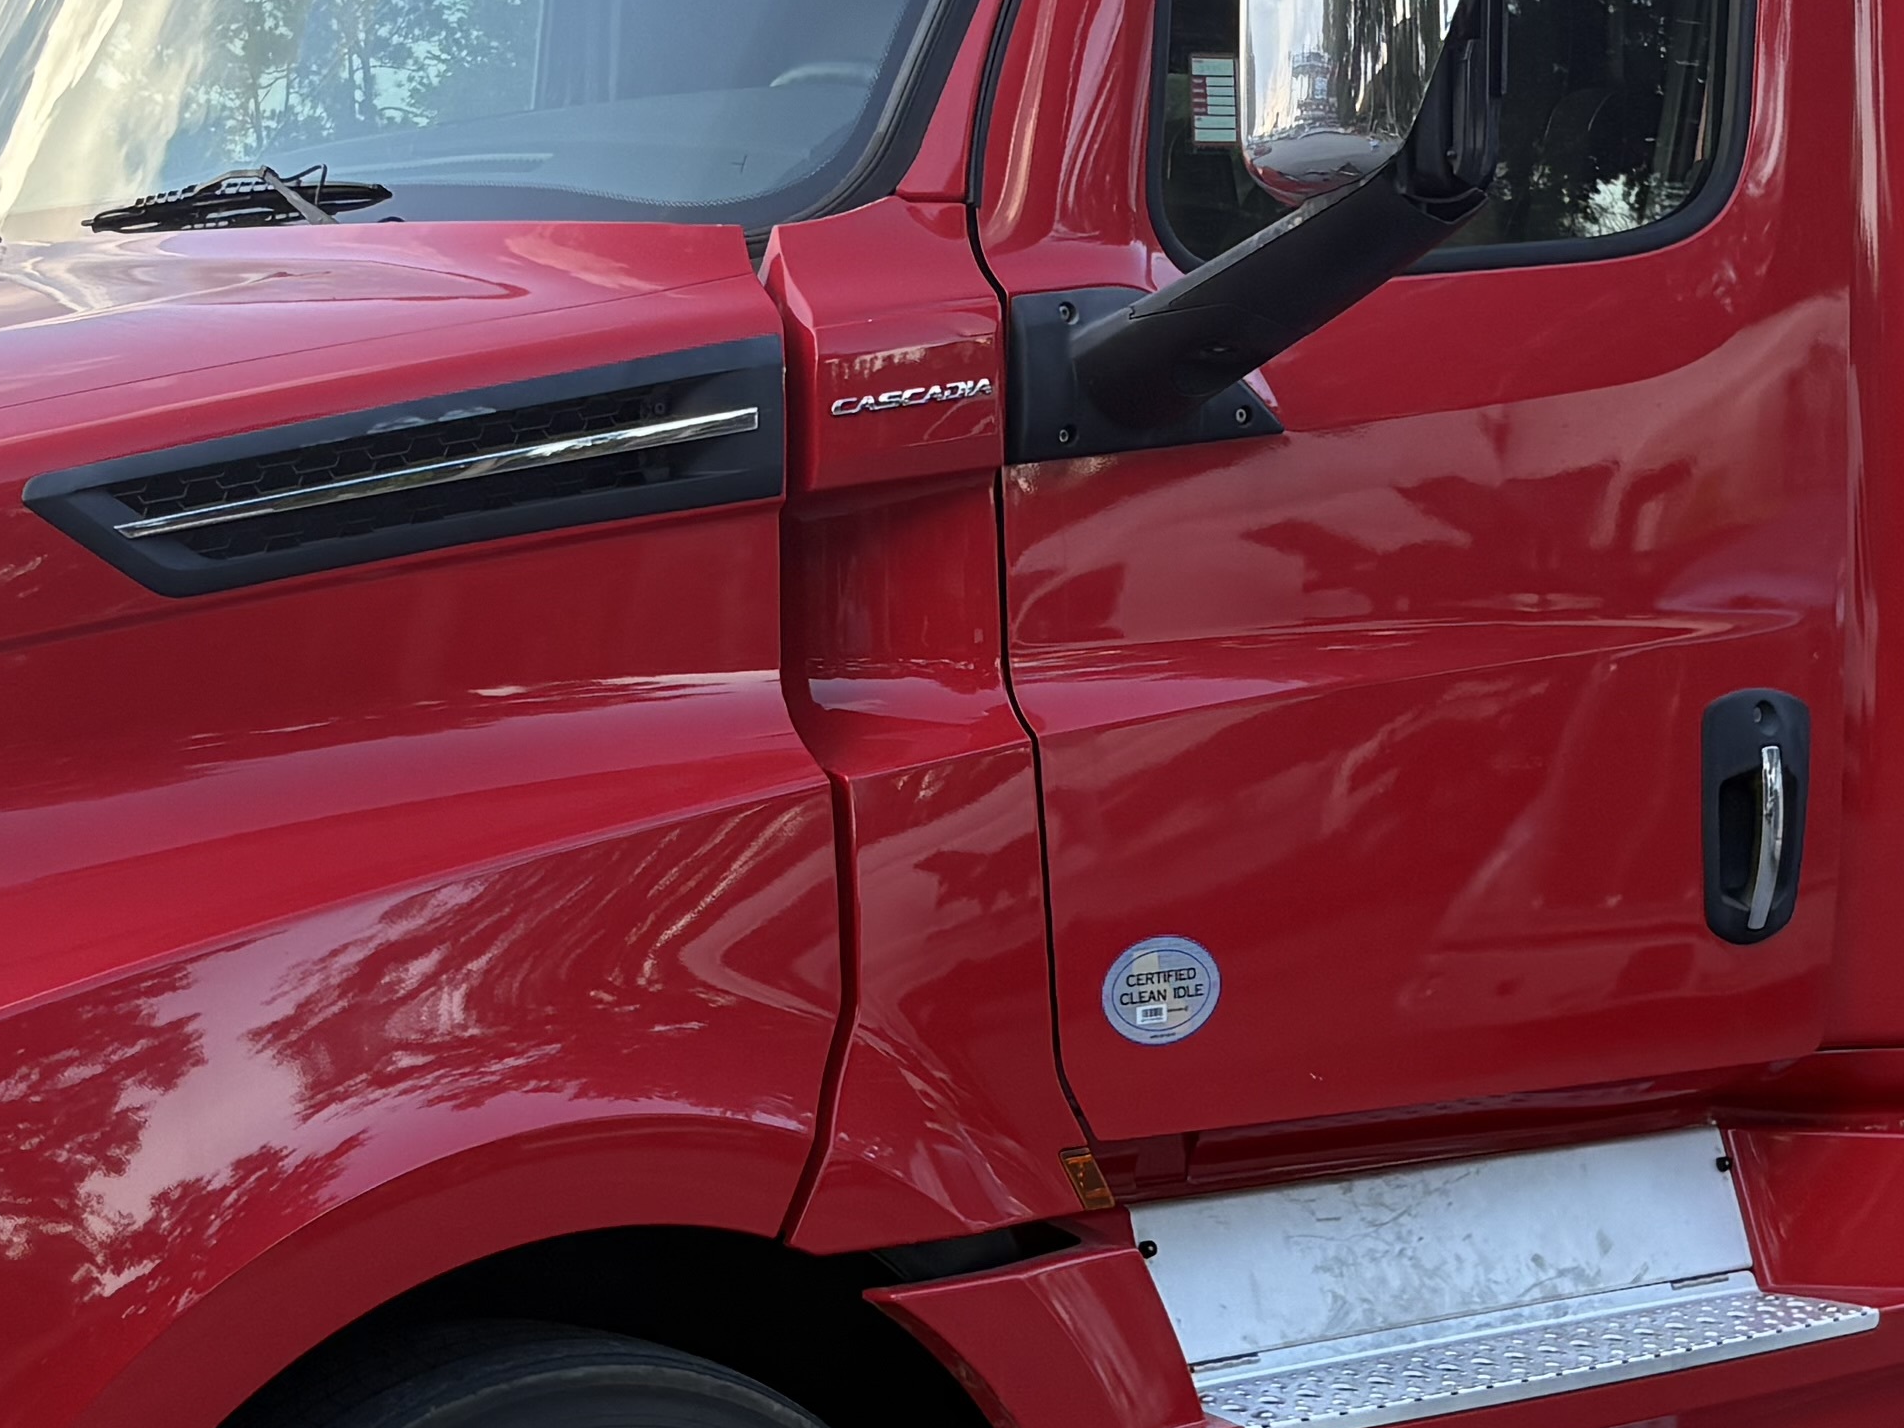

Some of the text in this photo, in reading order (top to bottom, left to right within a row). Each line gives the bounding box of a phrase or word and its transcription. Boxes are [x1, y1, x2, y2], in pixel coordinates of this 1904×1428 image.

[831, 377, 994, 416] CASCADIA
[1126, 967, 1197, 987] CERTIFIED
[1119, 983, 1204, 1006] CLEAN IDLE
